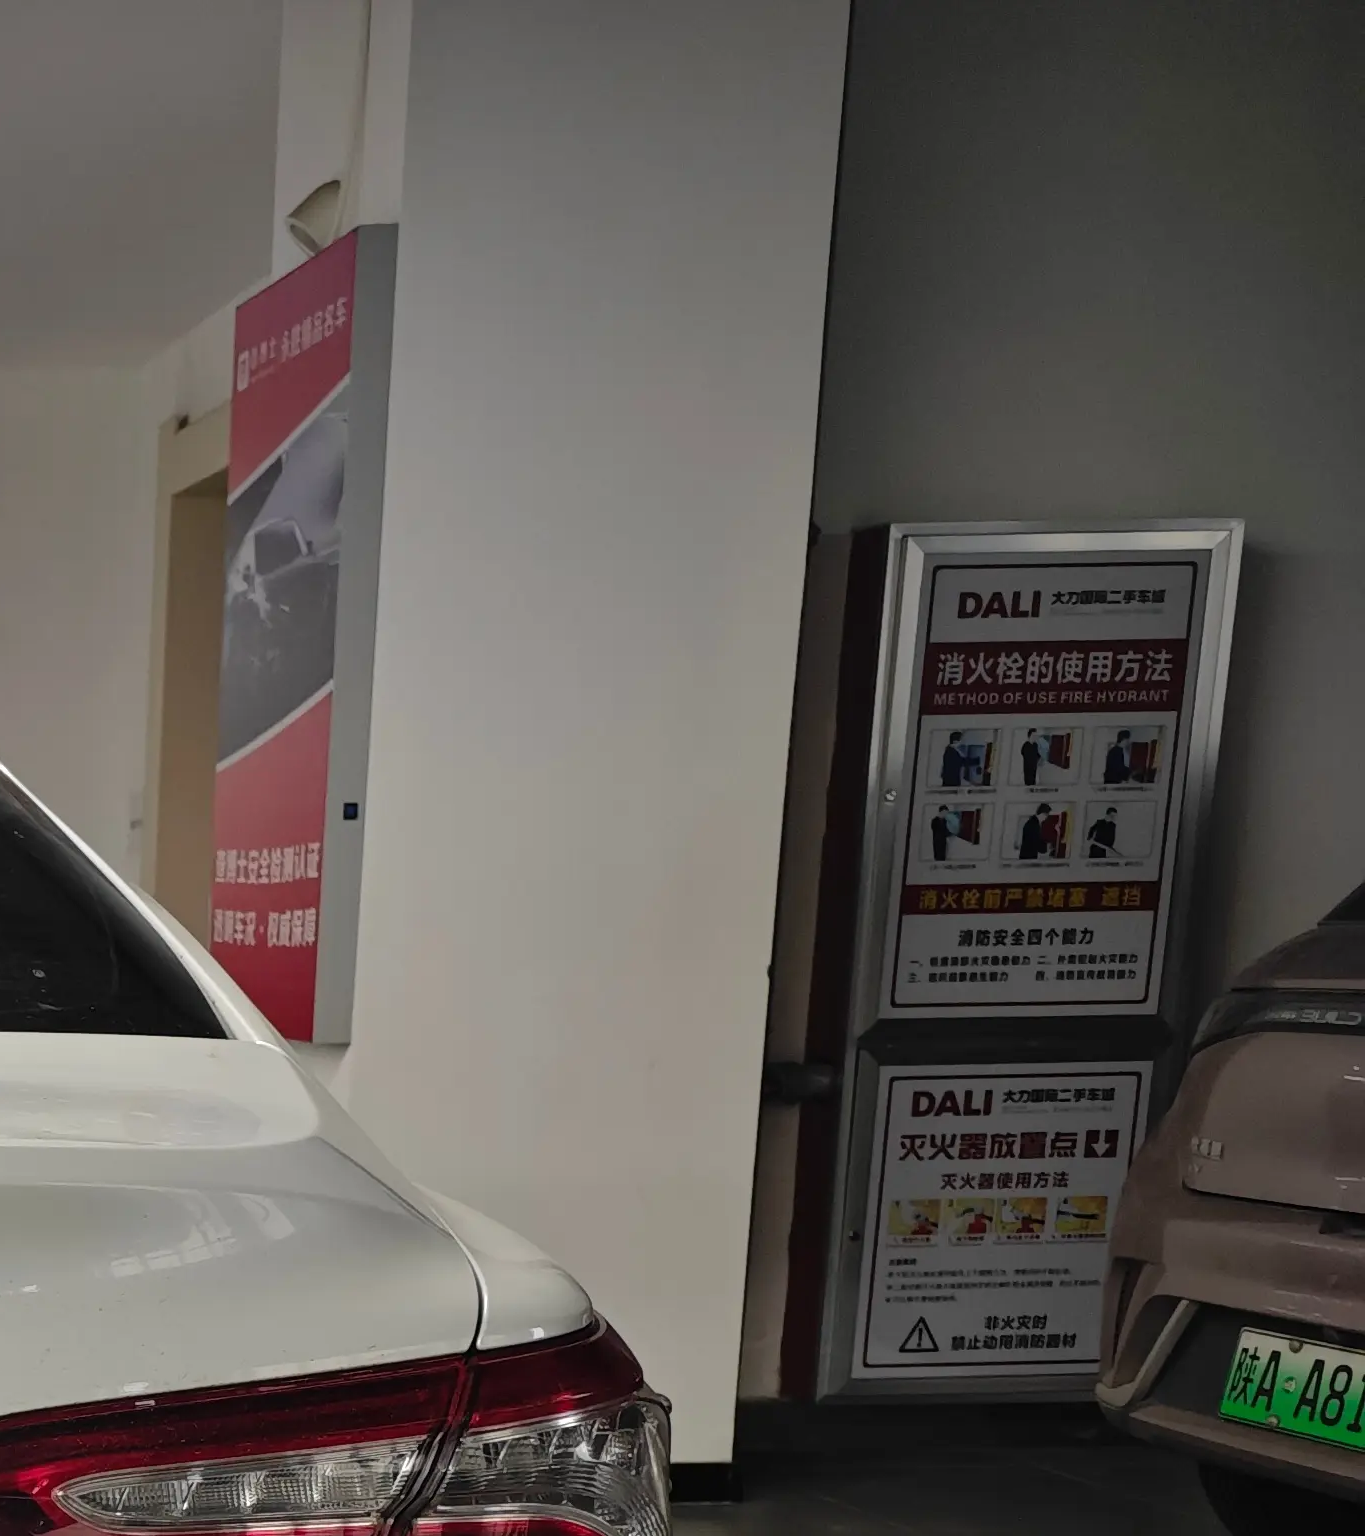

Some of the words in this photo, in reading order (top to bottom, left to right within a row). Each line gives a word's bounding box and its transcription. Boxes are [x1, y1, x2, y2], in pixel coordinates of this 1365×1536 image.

[957, 590, 1041, 619] DALI
[936, 649, 1174, 686] 消火栓的使用方法
[933, 692, 999, 706] METHOD
[1002, 691, 1023, 705] OF
[1027, 691, 1058, 705] USE
[1060, 690, 1092, 705] FIRE
[1096, 689, 1170, 704] HYDRANT
[911, 1089, 994, 1117] DALI
[898, 1131, 1078, 1161] 灭火器放置点
[940, 1171, 1069, 1190] 灭火器使用方法
